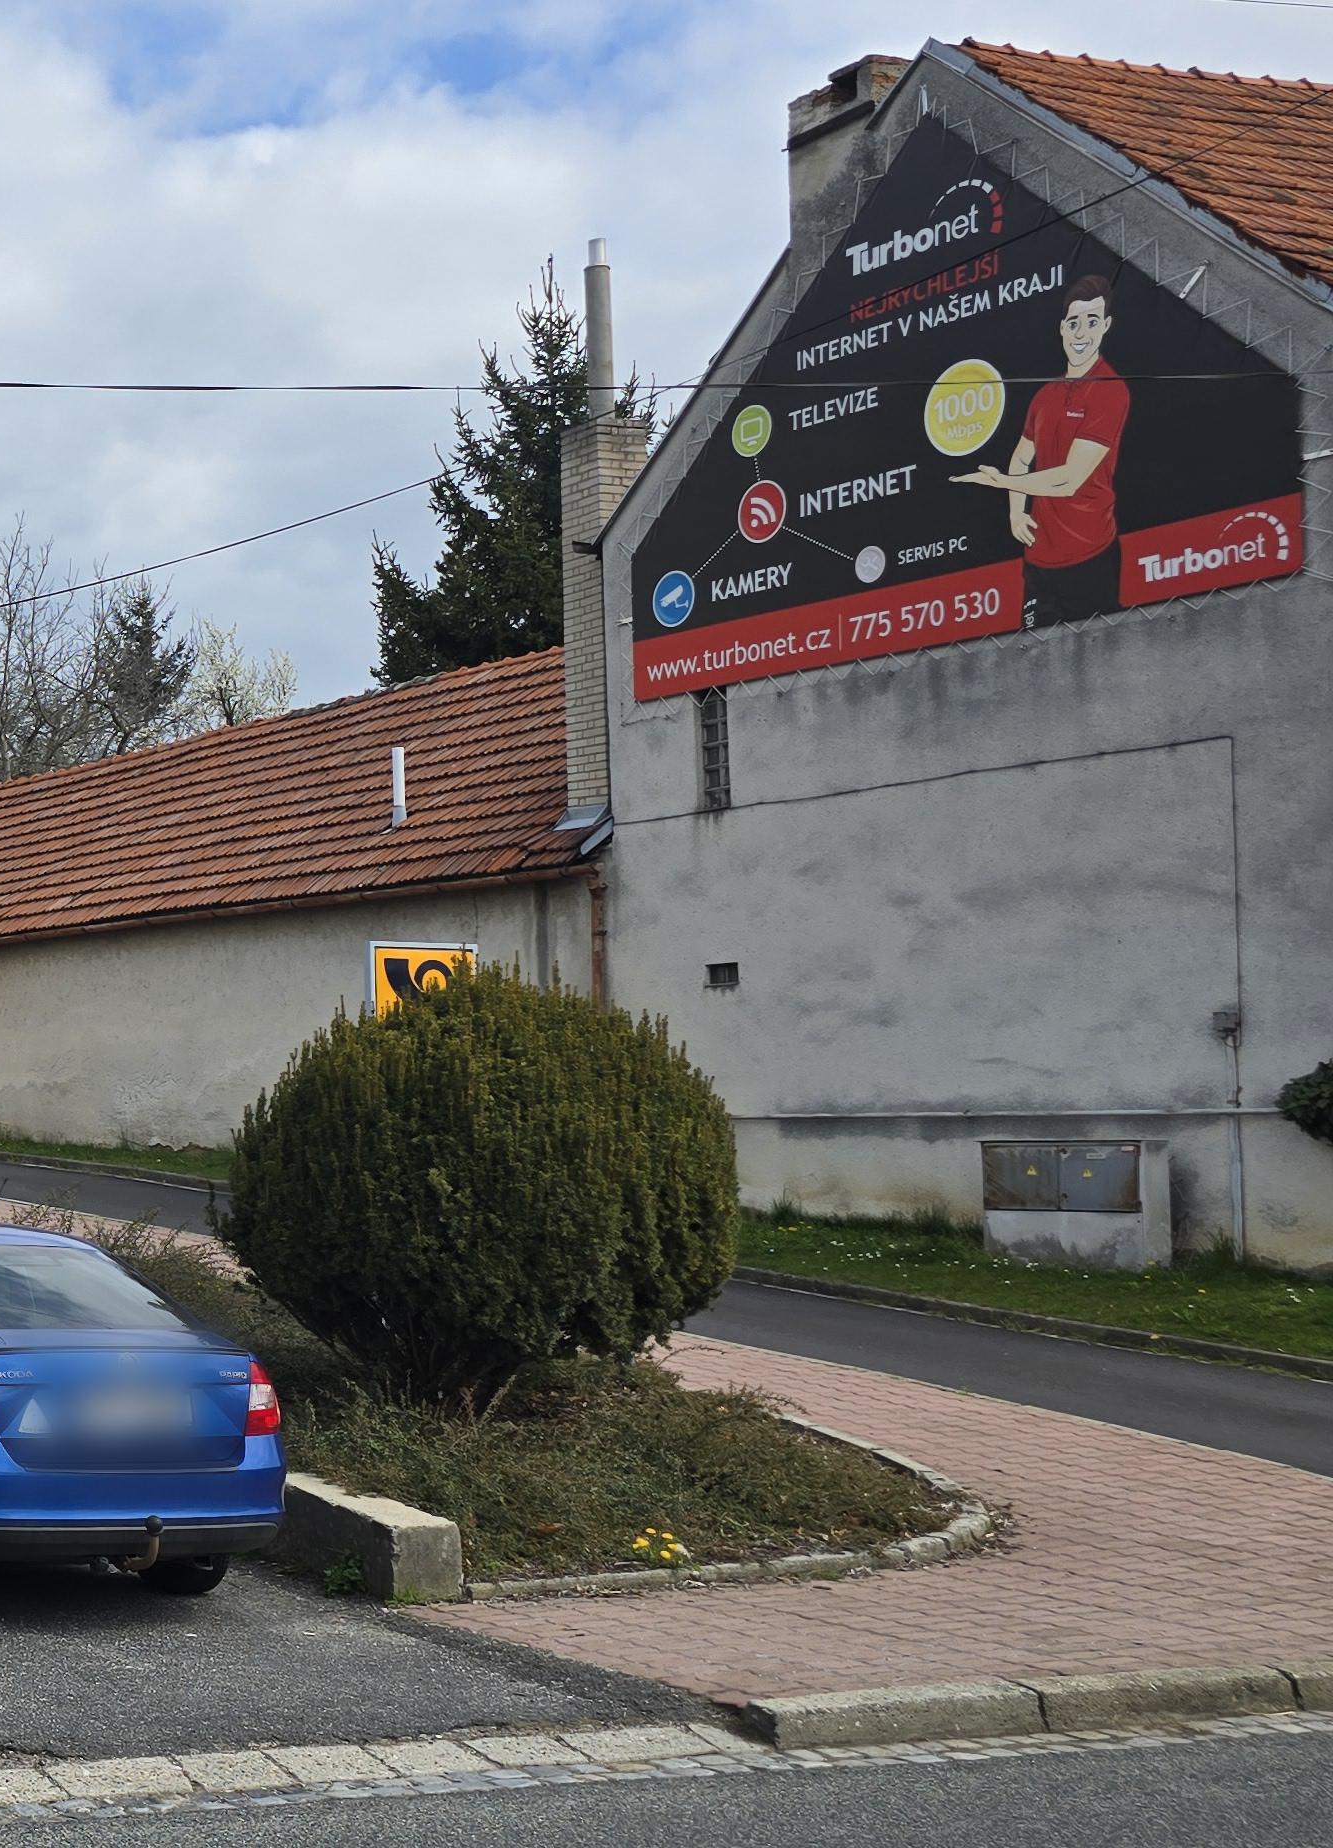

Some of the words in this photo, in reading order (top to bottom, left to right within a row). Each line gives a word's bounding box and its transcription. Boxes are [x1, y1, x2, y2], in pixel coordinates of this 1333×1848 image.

[845, 204, 979, 276] Turbonet
[796, 321, 892, 371] INTERNET
[898, 314, 912, 337] V
[919, 289, 991, 332] NAŠEM
[998, 264, 1063, 306] KRAJI
[788, 386, 879, 431] TELEVIZE
[934, 382, 995, 424] 1000
[947, 421, 983, 440] Mbps
[799, 464, 917, 517] INTERNET
[897, 538, 944, 565] SERVIS
[948, 536, 968, 553] PC
[1138, 533, 1266, 583] Turbonet
[711, 562, 793, 602] KAMERY
[646, 627, 831, 682] www.turbonet.cz
[849, 610, 892, 643] 775
[900, 600, 945, 633] 570
[953, 588, 1000, 621] 530
